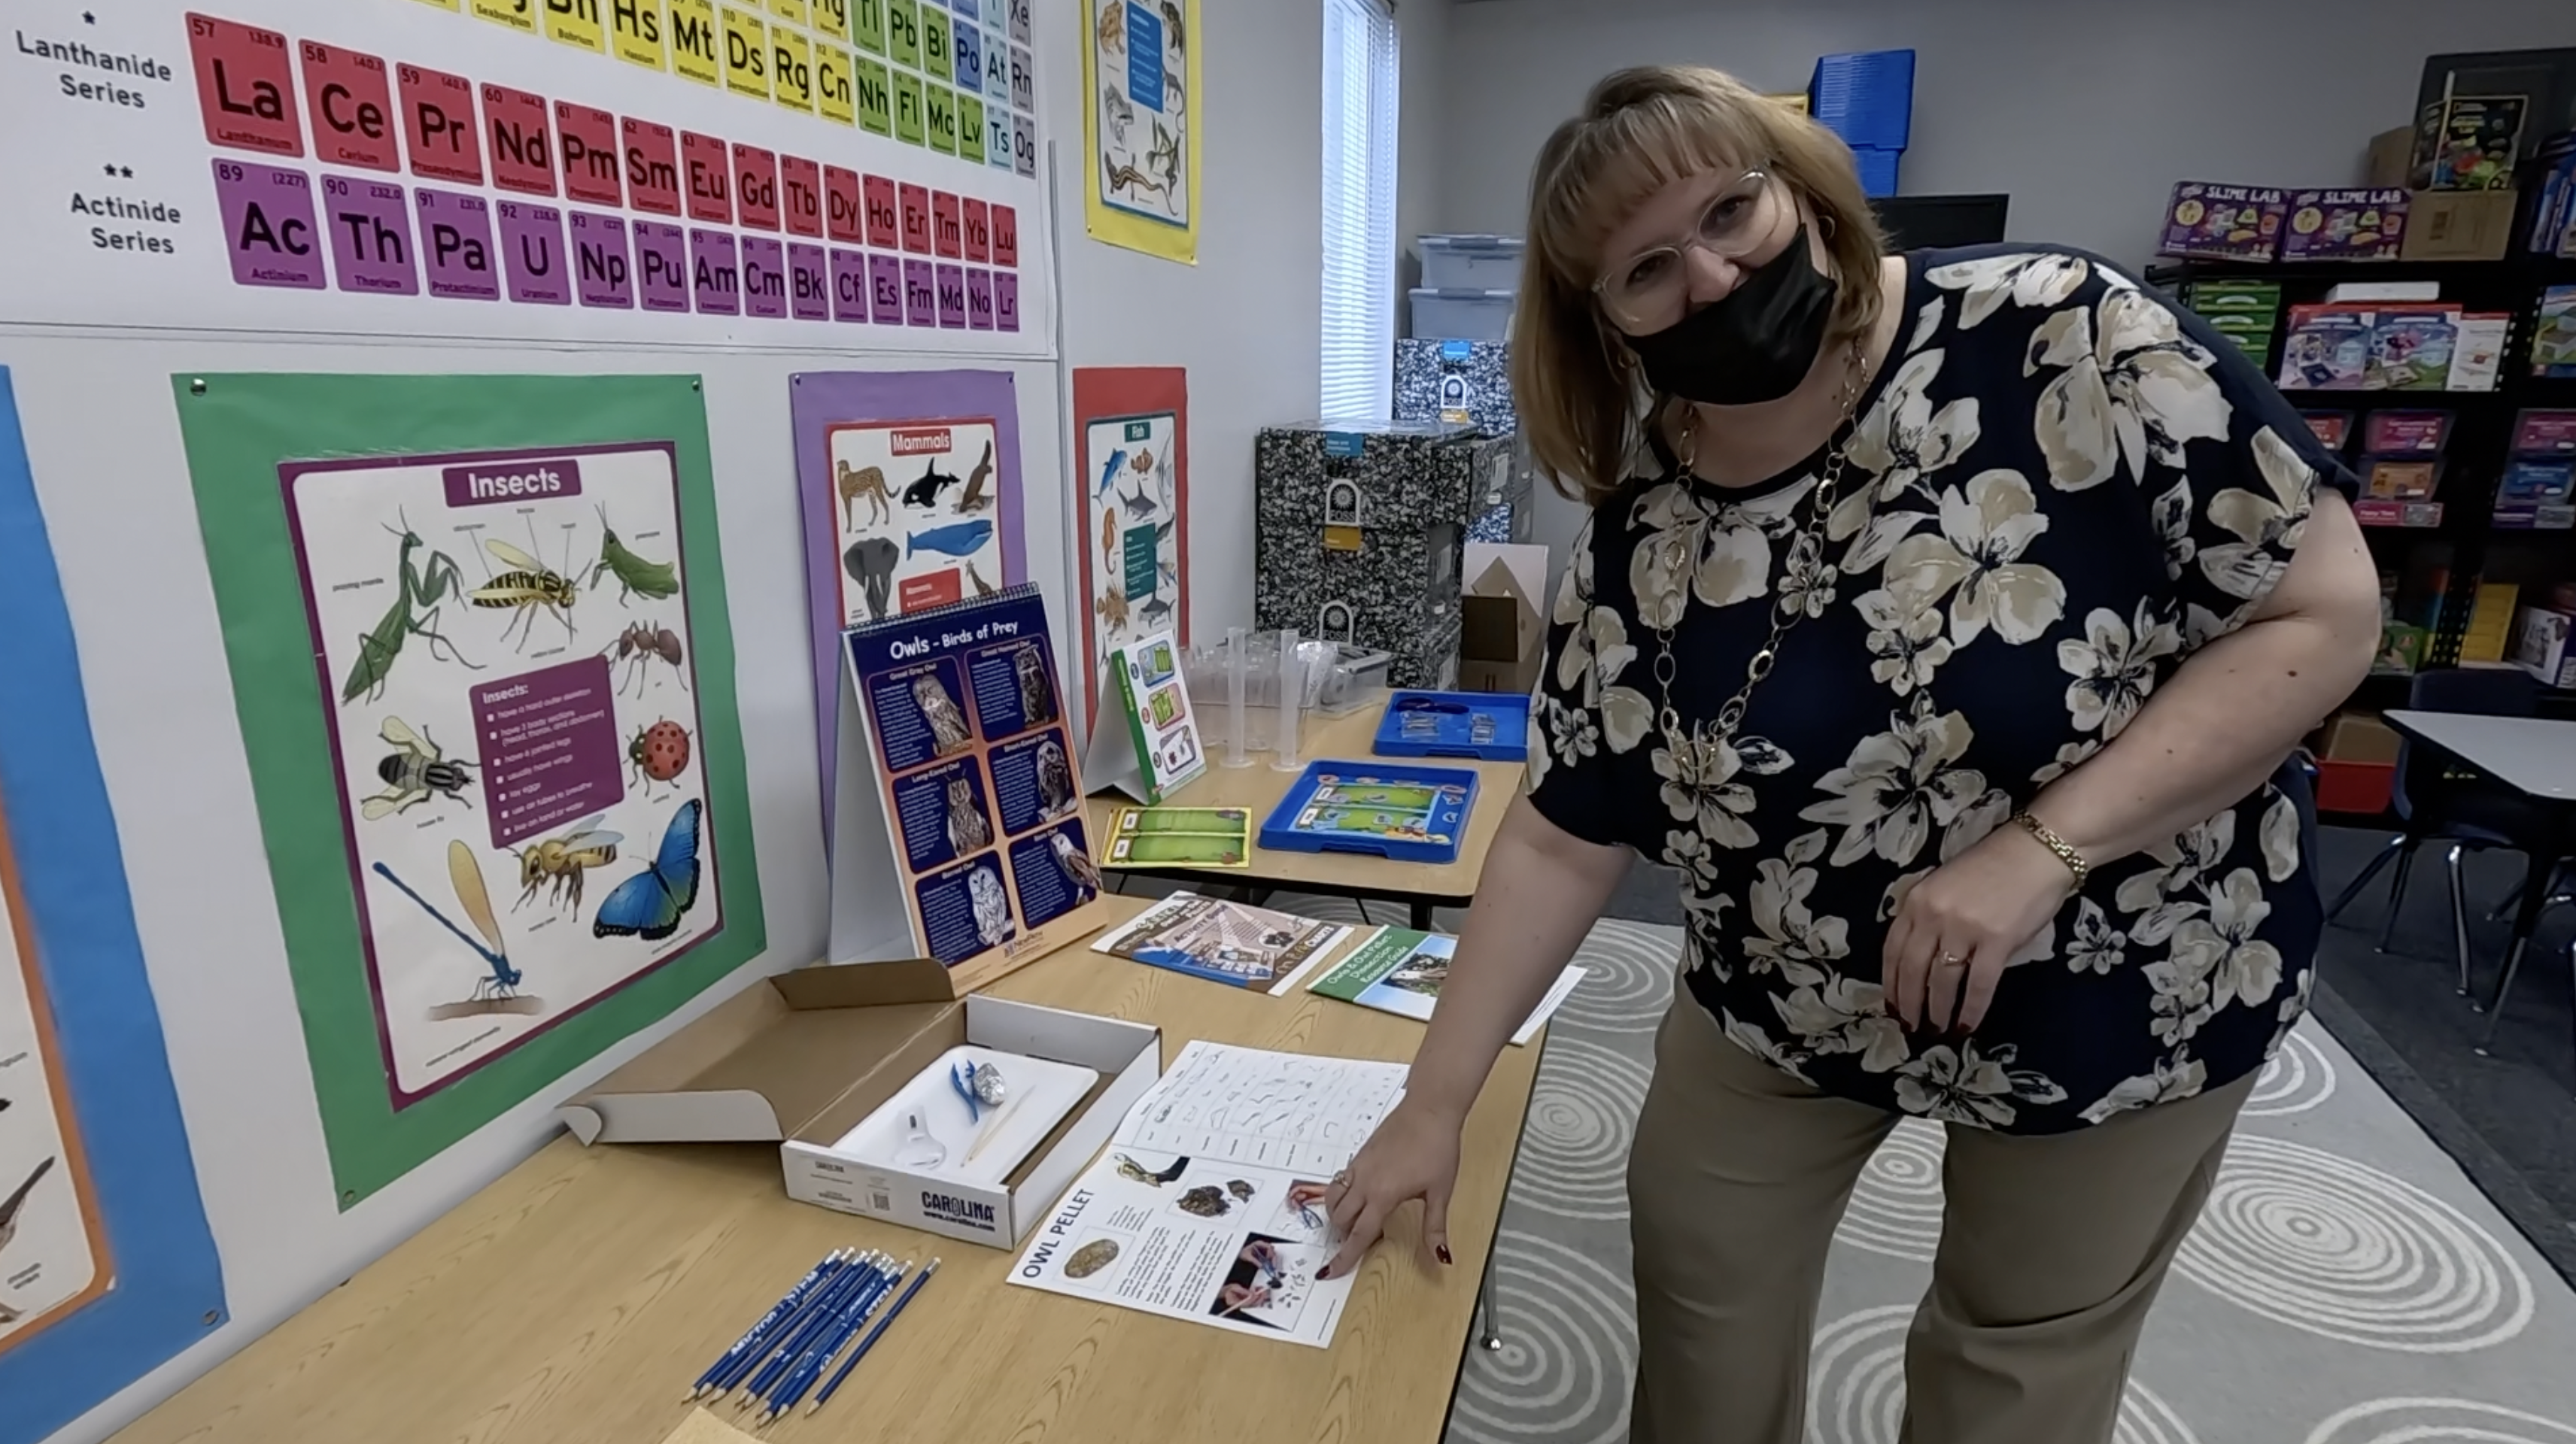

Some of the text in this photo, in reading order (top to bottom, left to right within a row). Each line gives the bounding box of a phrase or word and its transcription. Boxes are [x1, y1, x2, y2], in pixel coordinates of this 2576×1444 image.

[193, 18, 214, 38] 57
[613, 0, 658, 42] Hs
[673, 10, 715, 62] Mt
[891, 8, 916, 48] Pb
[15, 30, 172, 80] Lanthanide
[305, 45, 327, 64] 58
[728, 29, 764, 76] Ds
[928, 24, 946, 61] Bi
[957, 38, 979, 73] Po
[401, 68, 420, 85] 59
[775, 46, 810, 100] Rg
[819, 62, 850, 105] Cn
[988, 52, 1006, 84] At
[1012, 62, 1031, 96] Rn
[60, 74, 145, 109] Series
[212, 57, 284, 122] La
[485, 88, 503, 104] 60
[858, 75, 888, 116] Nh
[320, 83, 384, 139] Ce
[558, 106, 570, 119] 61
[900, 90, 917, 125] Fl
[928, 100, 954, 136] Mc
[417, 102, 465, 153] Pr
[624, 121, 637, 135] 62
[683, 135, 695, 148] 63
[961, 112, 980, 143] Lv
[990, 122, 1009, 153] Ts
[338, 147, 379, 164] Cerium
[494, 118, 548, 169] Nd
[561, 132, 618, 181] Pm
[1016, 131, 1034, 168] Og
[219, 164, 243, 182] 89
[272, 172, 306, 188] (227)
[627, 147, 677, 192] Sm
[690, 160, 725, 201] Eu
[326, 179, 348, 196] 90
[370, 186, 402, 200] 232.0
[418, 193, 435, 208] 91
[741, 171, 774, 209] Gd
[787, 180, 816, 217] Tb
[2206, 186, 2280, 203] SLIME LAB
[2322, 191, 2401, 204] SLIME LAB
[71, 192, 181, 224] Actinide
[500, 204, 517, 219] 92
[572, 214, 586, 228] 93
[831, 190, 857, 231] Dy
[868, 198, 895, 229] Ho
[906, 206, 925, 235] Er
[91, 227, 175, 253] Series
[240, 201, 310, 256] Ac
[339, 212, 404, 263] Th
[635, 223, 649, 235] 94
[934, 211, 959, 242] Tm
[966, 218, 986, 246] Yb
[995, 223, 1013, 251] Lu
[432, 224, 487, 272] Pa
[521, 235, 549, 277] U
[251, 268, 308, 281] Actinium
[354, 275, 401, 289] Thorium
[579, 241, 625, 292] Np
[643, 249, 682, 289] Pu
[694, 256, 738, 294] Am
[745, 261, 785, 297] Cm
[794, 267, 825, 301] Bk
[839, 272, 860, 302] Cf
[876, 277, 897, 306] Es
[907, 281, 933, 309] Fm
[940, 284, 964, 311] Md
[970, 287, 990, 314] No
[999, 291, 1013, 315] Lr
[892, 432, 950, 452] Mammals
[1132, 425, 1144, 438] Fish
[468, 468, 561, 499] Insects
[1329, 511, 1355, 520] FOSS
[890, 636, 930, 660] Owls
[942, 629, 973, 648] Birds
[977, 624, 989, 639] of
[992, 621, 1018, 636] Prey
[1324, 631, 1347, 640] FOSS
[482, 684, 529, 704] Insects:
[922, 1191, 995, 1222] CAROLINA
[923, 1211, 995, 1231] www.carolina.com
[1022, 1188, 1095, 1279] OWL PELLET
